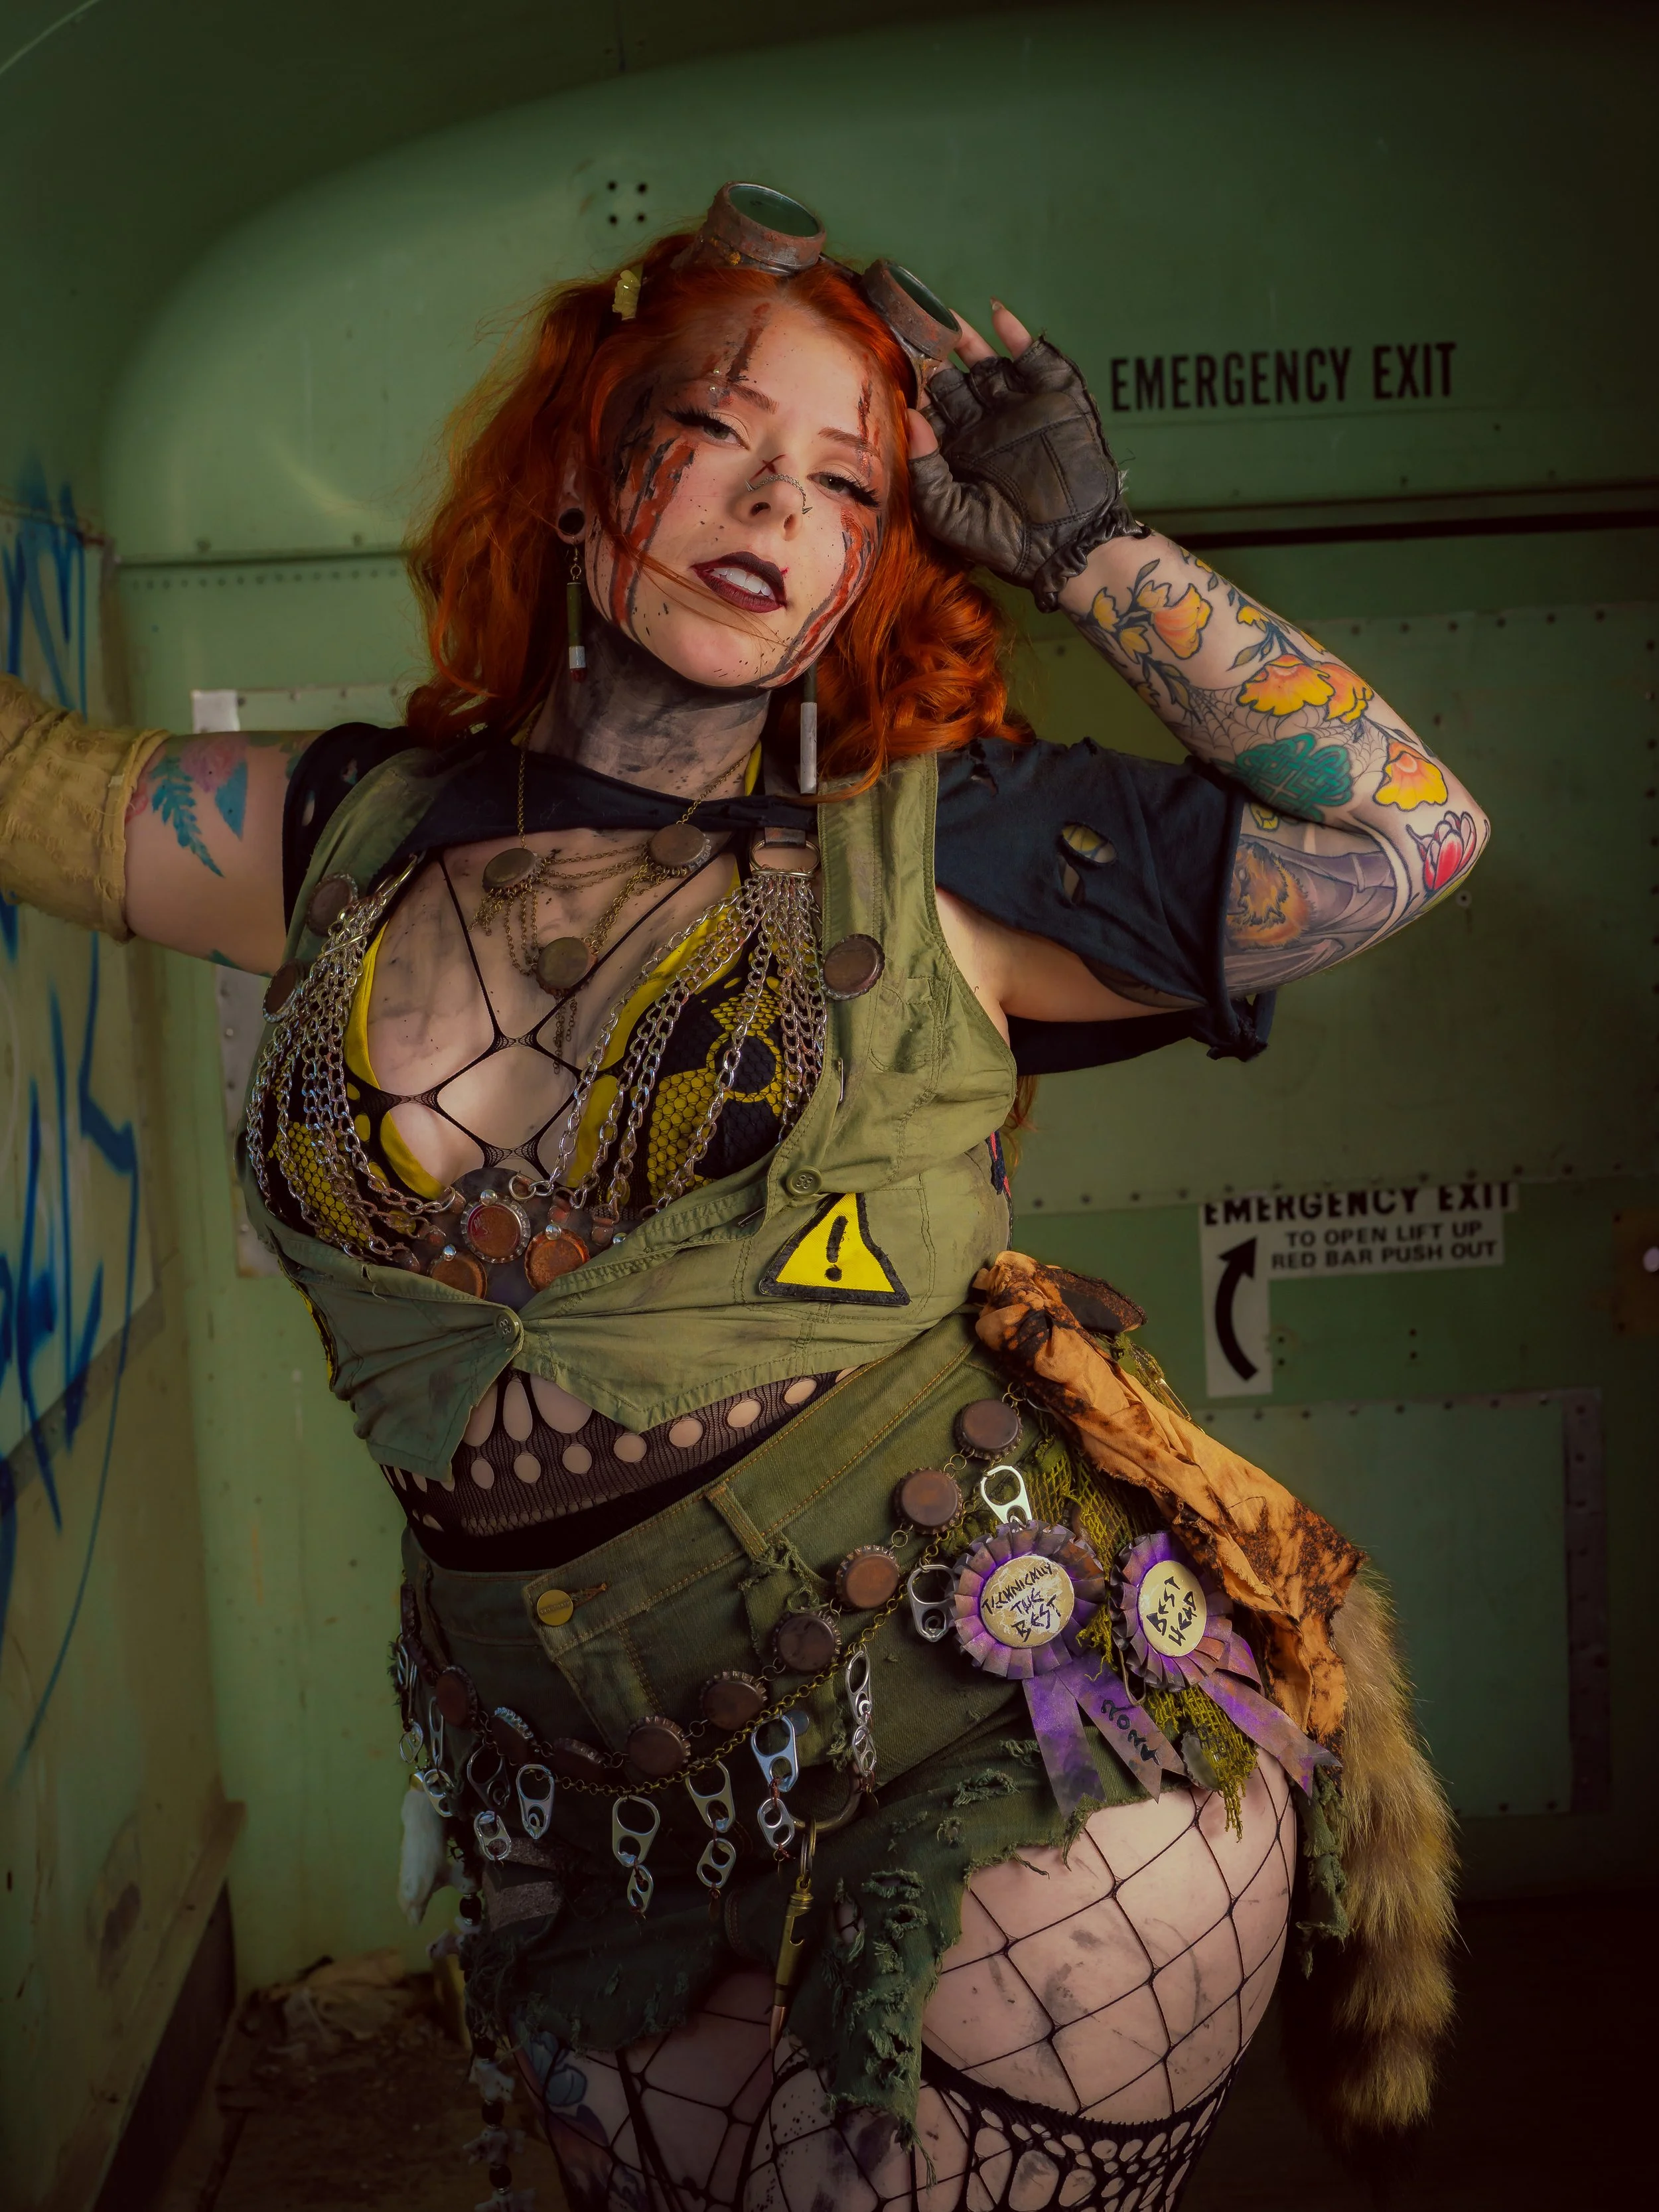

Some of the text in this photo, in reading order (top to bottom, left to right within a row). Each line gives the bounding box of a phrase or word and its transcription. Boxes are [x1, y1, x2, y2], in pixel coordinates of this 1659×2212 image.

[1110, 342, 1457, 412] EMERGENCY EXIT
[1204, 1187, 1419, 1226] EMERGENCY
[1271, 1240, 1496, 1270] RED BAR PUSH OUT
[1287, 1220, 1482, 1248] TO OPEN LIFT UP
[1009, 1587, 1045, 1616] THE
[1011, 1593, 1062, 1643] BEST
[1146, 1576, 1181, 1637] BEST
[1168, 1591, 1198, 1647] HEAD
